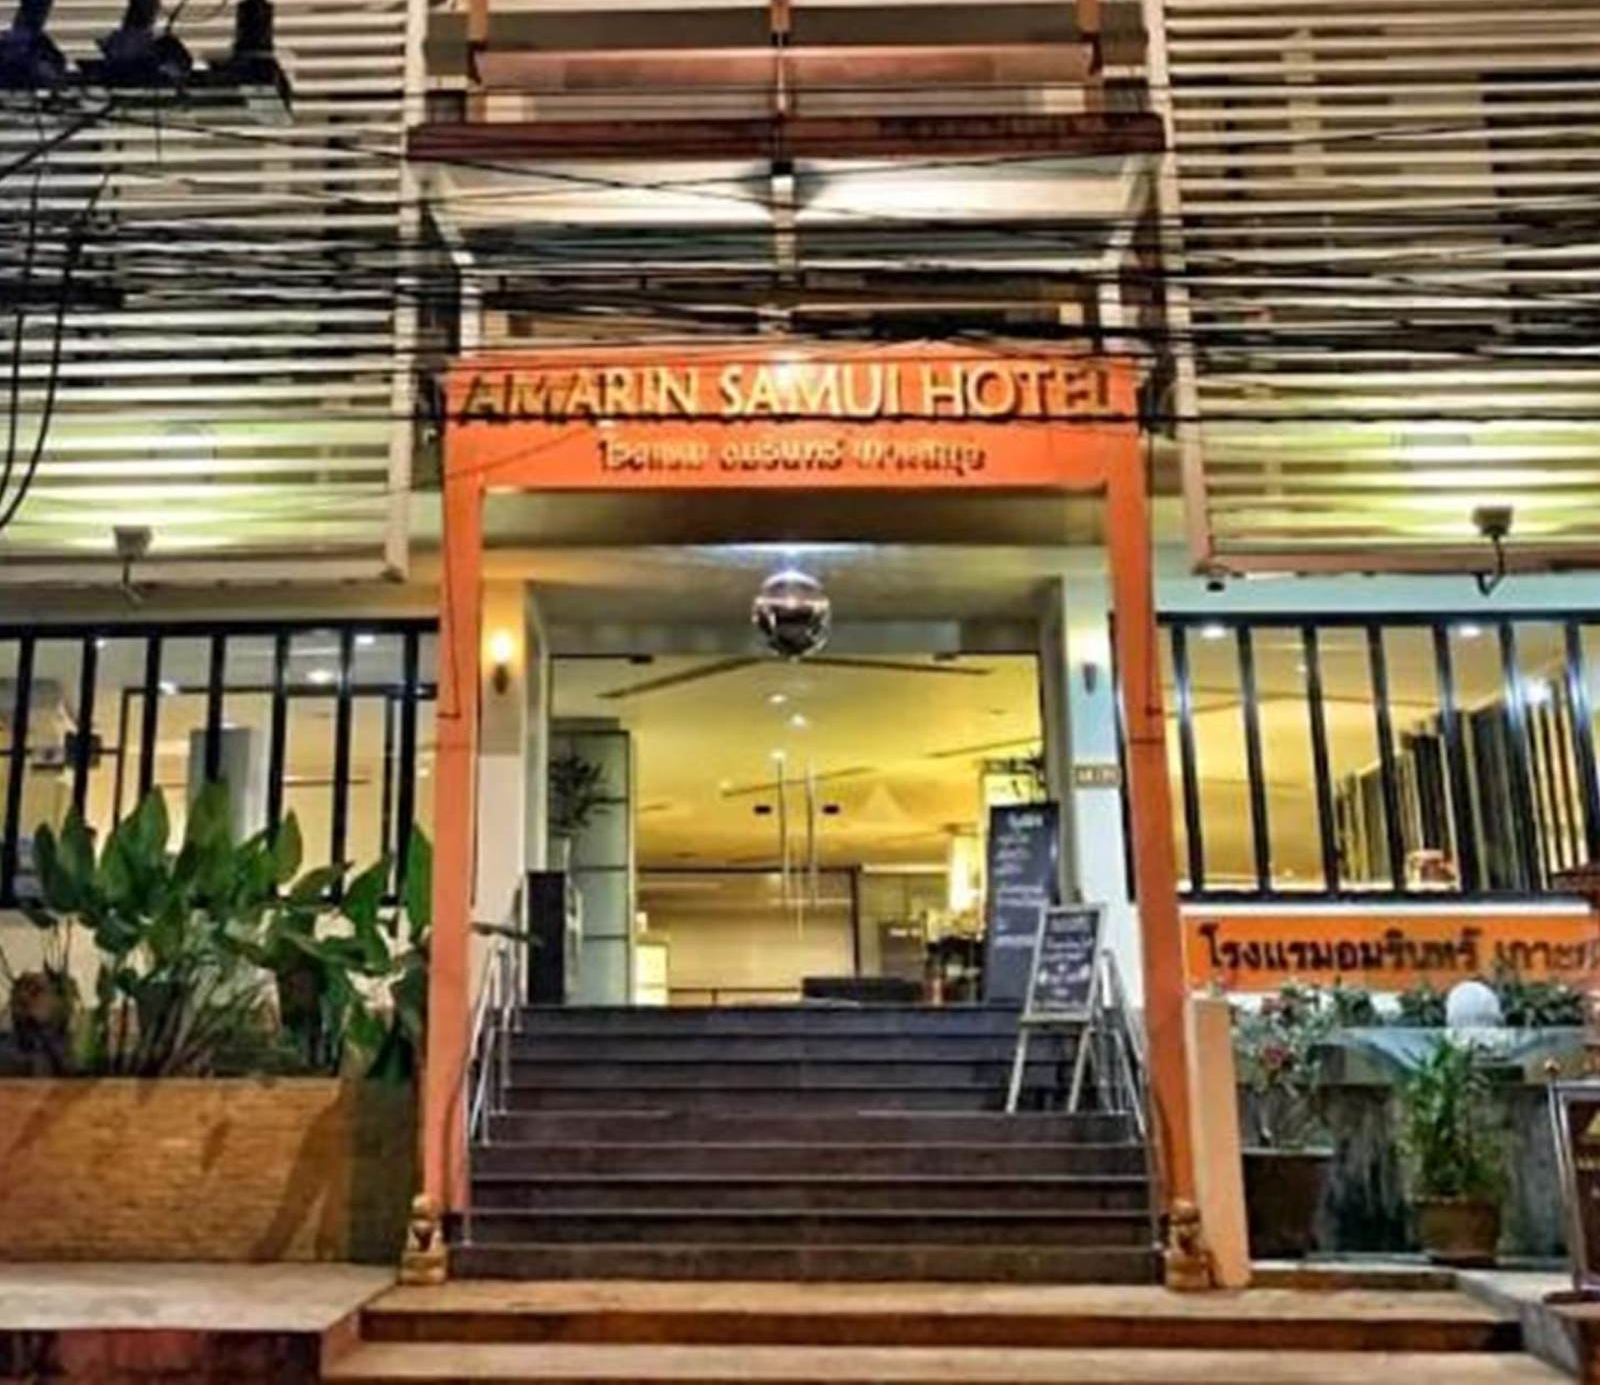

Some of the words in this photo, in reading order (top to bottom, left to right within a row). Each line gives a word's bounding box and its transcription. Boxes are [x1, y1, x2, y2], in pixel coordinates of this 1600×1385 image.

[460, 365, 700, 419] AMARIN
[718, 363, 901, 418] SAMUI
[921, 363, 1120, 419] HOTEL
